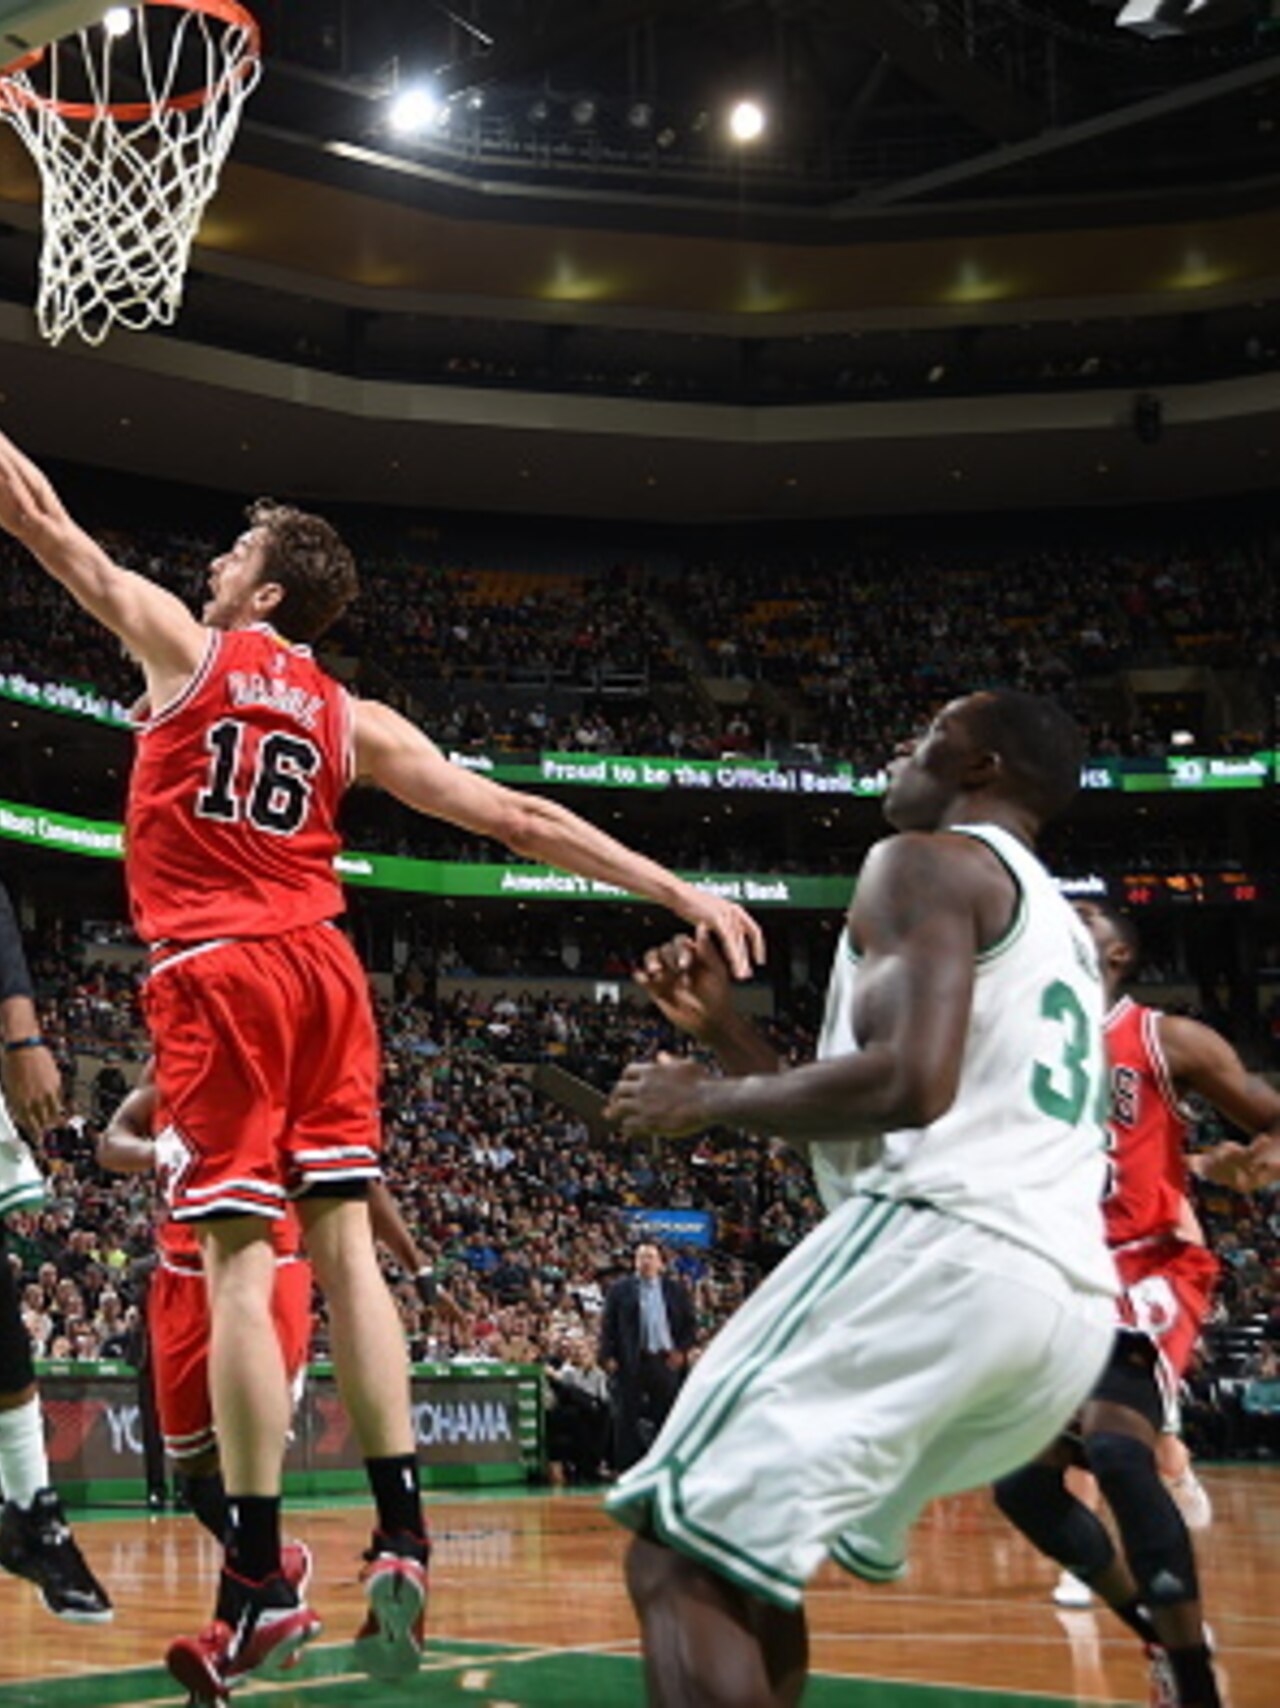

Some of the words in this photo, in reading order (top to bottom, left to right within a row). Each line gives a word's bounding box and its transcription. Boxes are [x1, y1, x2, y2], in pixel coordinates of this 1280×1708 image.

[194, 716, 322, 838] 16
[543, 759, 607, 783] Proud
[1031, 978, 1107, 1127] 3
[412, 1402, 512, 1446] OHAMA
